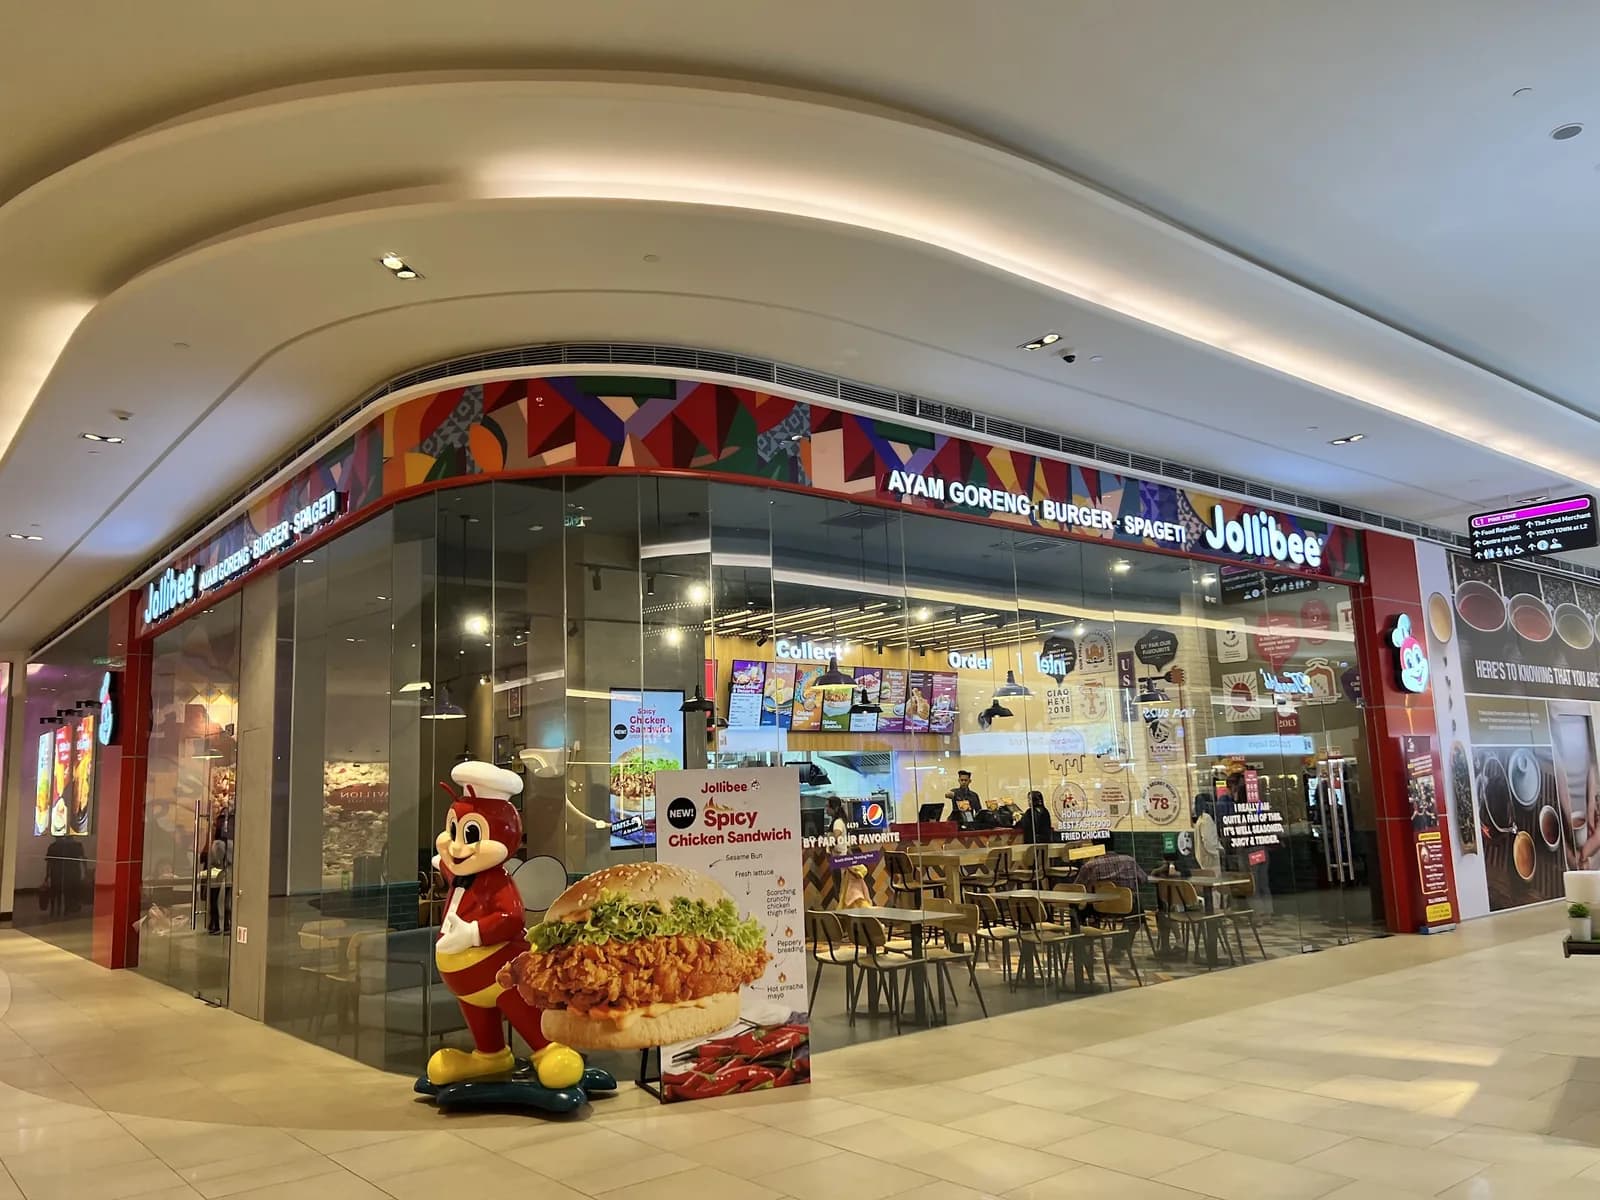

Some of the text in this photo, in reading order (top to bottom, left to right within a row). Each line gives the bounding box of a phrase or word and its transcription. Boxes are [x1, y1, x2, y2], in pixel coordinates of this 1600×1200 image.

[888, 470, 1186, 543] AYAM GORENG BURGER SPAGETI
[1562, 512, 1591, 522] Merchant
[1496, 524, 1520, 533] Republic
[1536, 528, 1555, 537] TOKYO
[1555, 526, 1572, 534] TOWN
[199, 490, 336, 590] AYAM GORENG BURGER SPAGETI
[1205, 504, 1321, 567] Jollibee
[144, 566, 195, 624] Jollibee
[776, 639, 843, 660] Collect
[949, 651, 992, 669] Order
[1475, 659, 1600, 688] HERE'S TO KNOWING THAT YOU ARE
[629, 715, 666, 725] Chicken
[1279, 719, 1297, 727] 2013
[629, 724, 673, 734] Sandwich
[701, 780, 748, 794] Jollibee
[1238, 802, 1259, 812] REALLY
[669, 808, 694, 818] NEW!
[1062, 810, 1081, 818] HONG
[704, 810, 758, 830] Spicy
[1222, 815, 1241, 825] QUITE
[1242, 815, 1247, 823] A
[1247, 814, 1259, 823] FAN
[1259, 814, 1267, 822] OF
[1058, 821, 1076, 830] BEST
[1061, 830, 1111, 841] FRIED CHICKEN
[1223, 827, 1235, 837] IT'S
[1236, 826, 1252, 835] WELL
[668, 828, 792, 848] Chicken Sandwich
[803, 832, 900, 848] BY FAR OUR FAVORITE
[1231, 838, 1249, 848] JUICY
[1250, 837, 1255, 845] &
[725, 852, 763, 861] Sesame Bun
[735, 869, 774, 879] Fresh lettuce
[766, 888, 796, 896] Scorching
[767, 902, 790, 910] chicken
[767, 909, 782, 917] thigh
[777, 939, 801, 947] Peppery
[777, 945, 804, 953] breading
[780, 983, 804, 991] sriracha
[767, 992, 784, 1000] mayo
